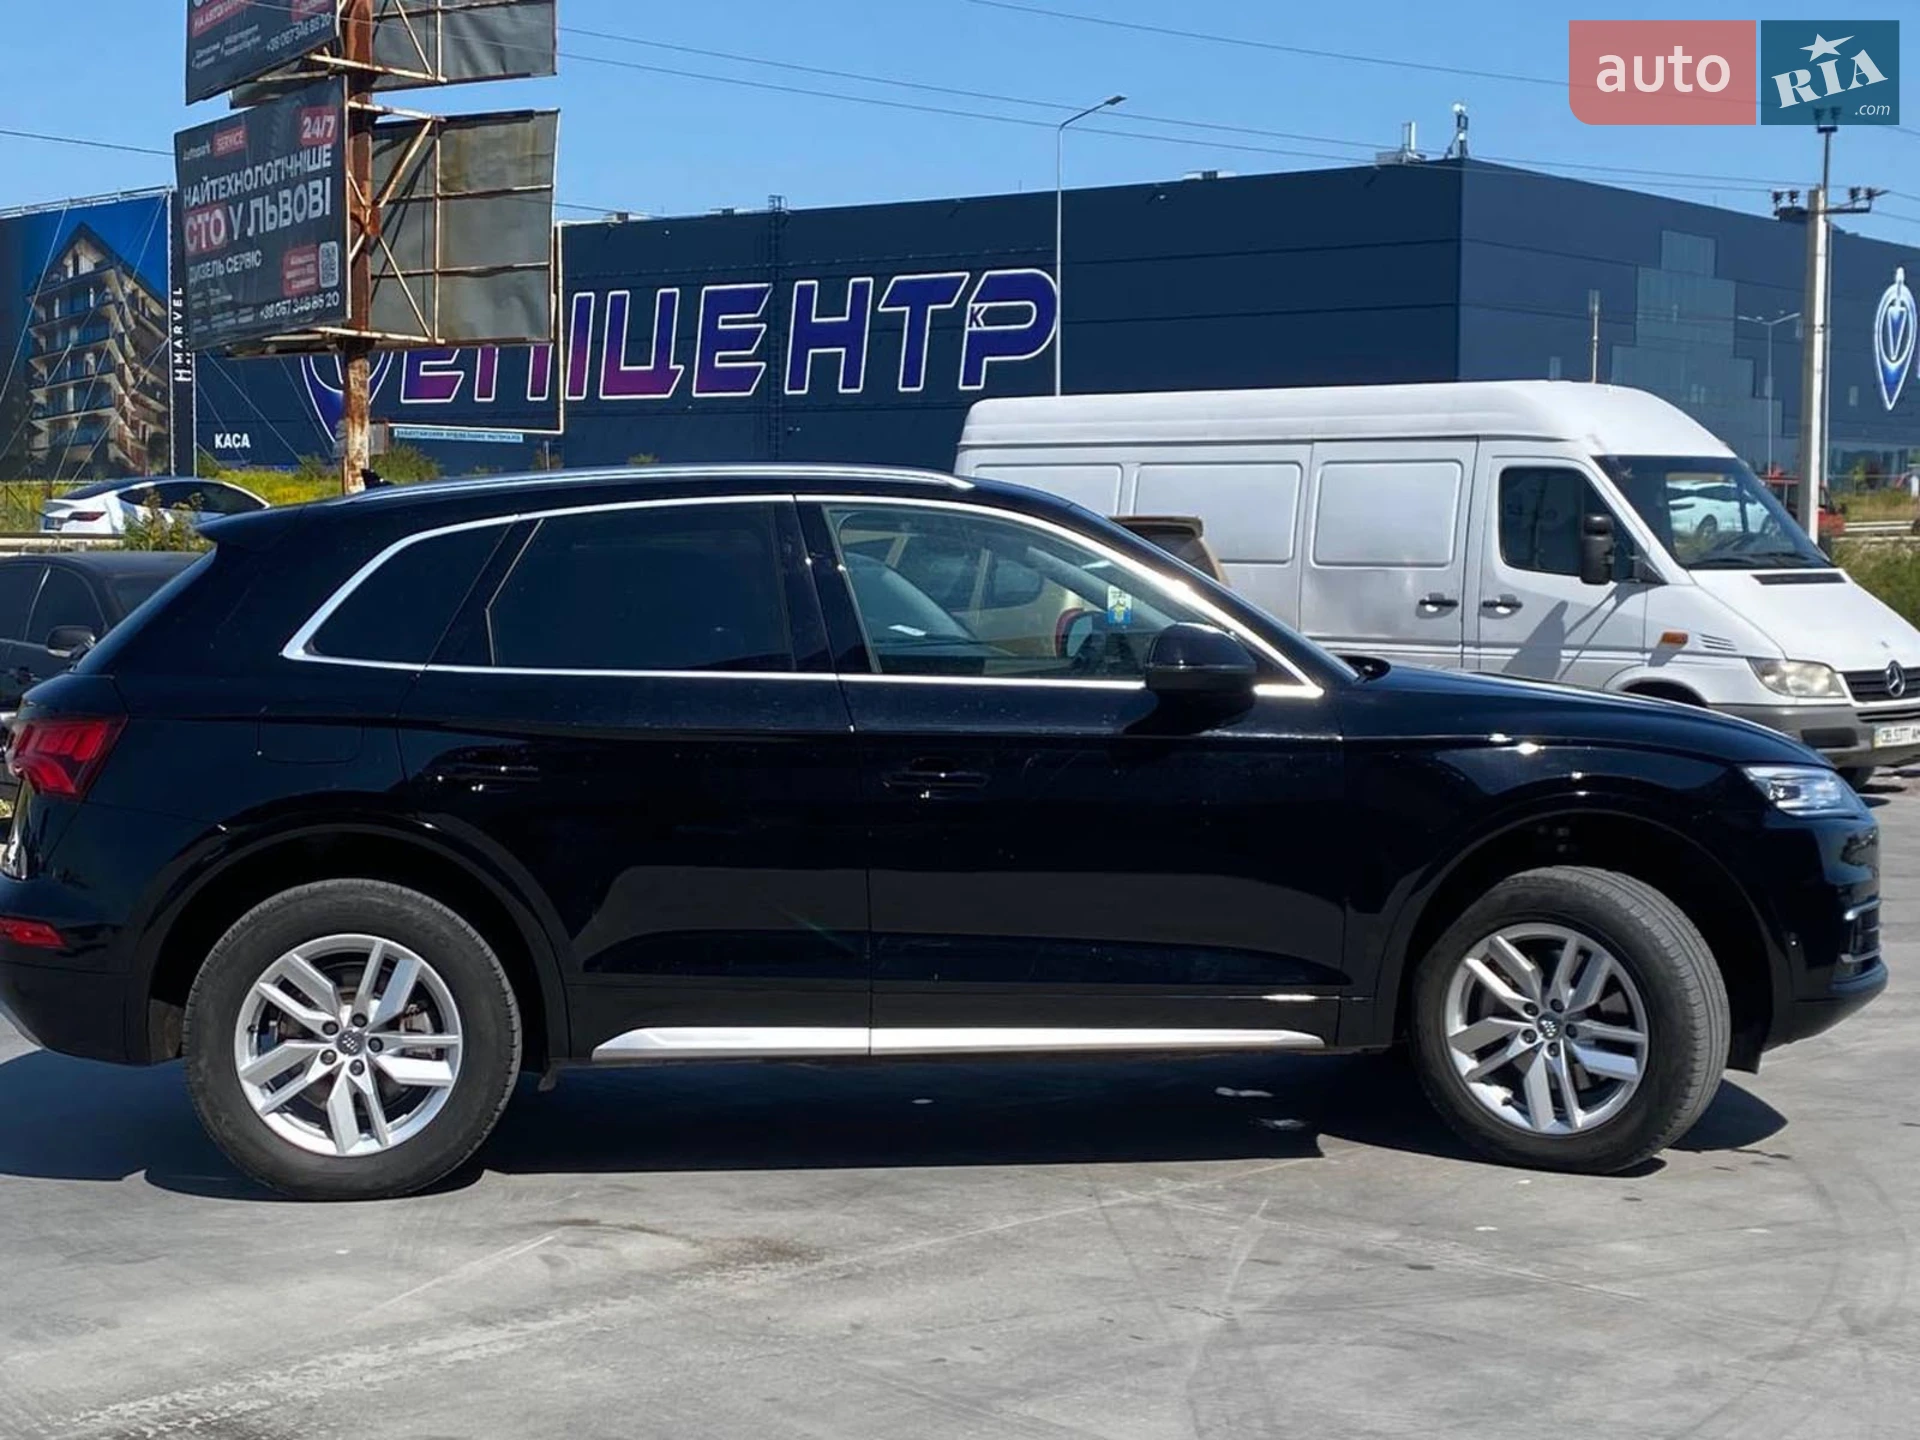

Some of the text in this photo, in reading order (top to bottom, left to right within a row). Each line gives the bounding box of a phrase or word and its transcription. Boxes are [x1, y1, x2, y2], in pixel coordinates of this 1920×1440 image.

[302, 115, 336, 139] 24/7
[183, 144, 332, 208] НАЙТЕХНОЛОГІЧНІШЕ
[185, 177, 331, 250] СТО У ЛЬВОВІ
[226, 250, 263, 274] СЕРВІС
[325, 291, 340, 307] 20
[173, 287, 183, 364] MARVEL
[214, 433, 251, 449] КАСА
